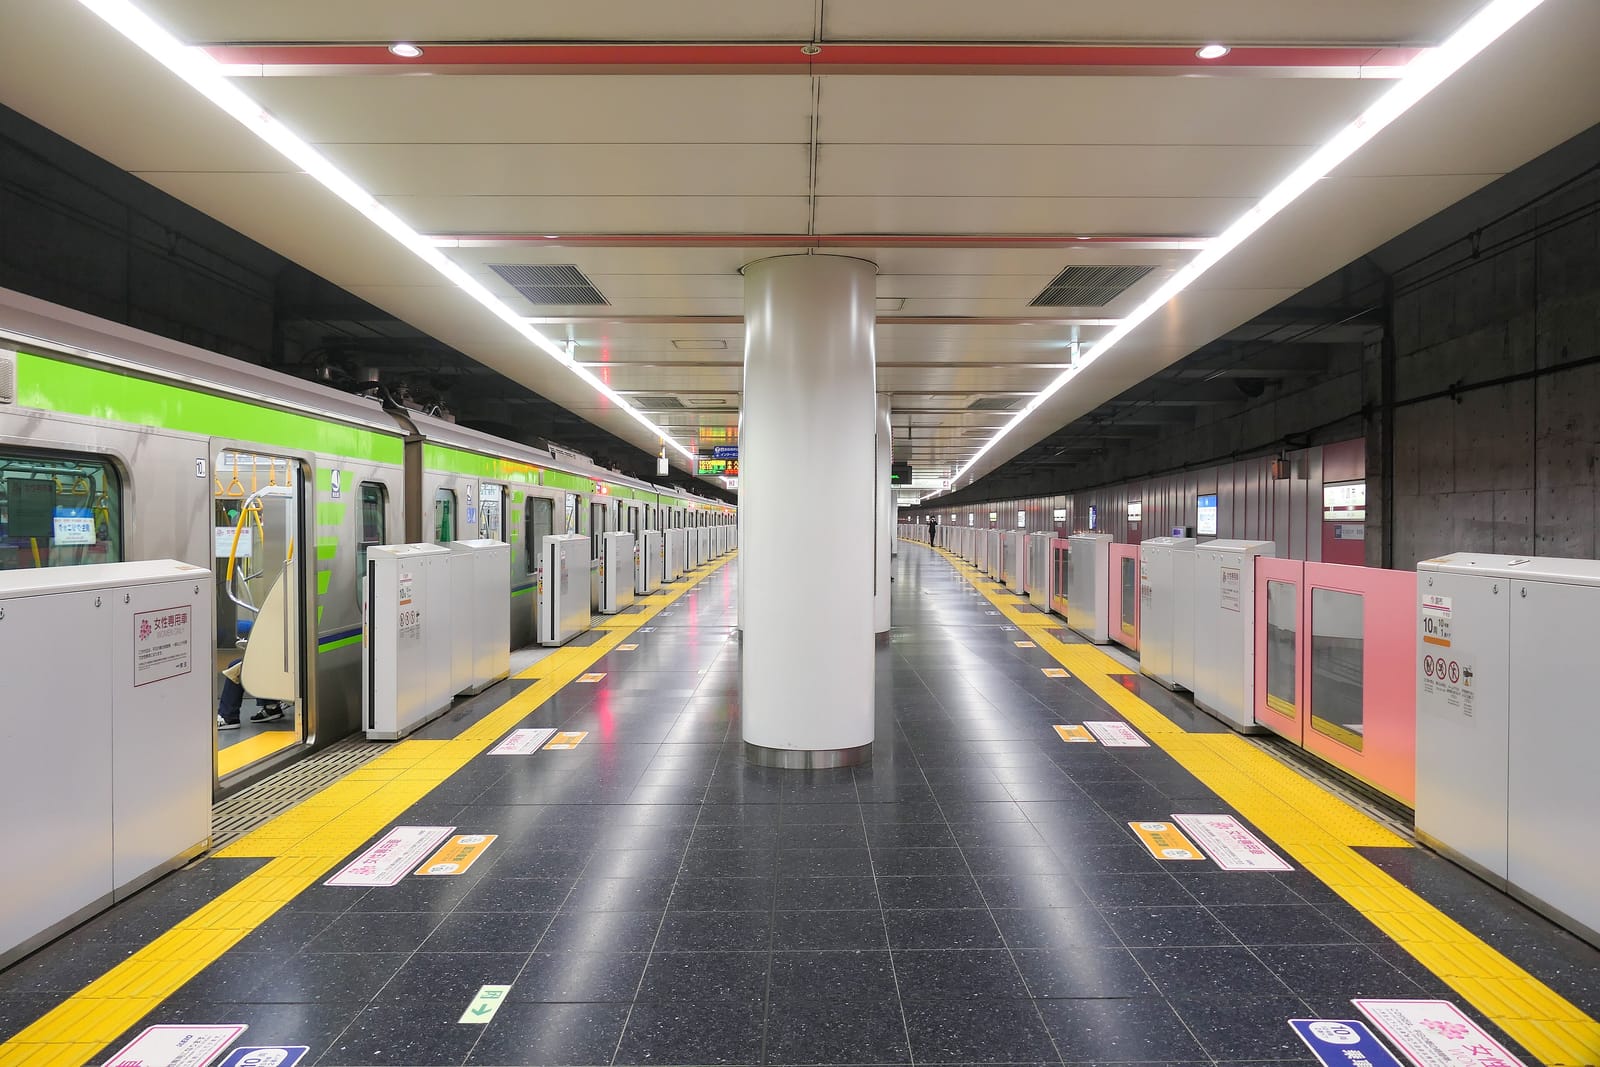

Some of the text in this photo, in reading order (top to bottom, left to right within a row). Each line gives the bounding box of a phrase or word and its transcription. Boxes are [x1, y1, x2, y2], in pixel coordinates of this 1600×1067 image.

[154, 613, 187, 630] 女性専用車
